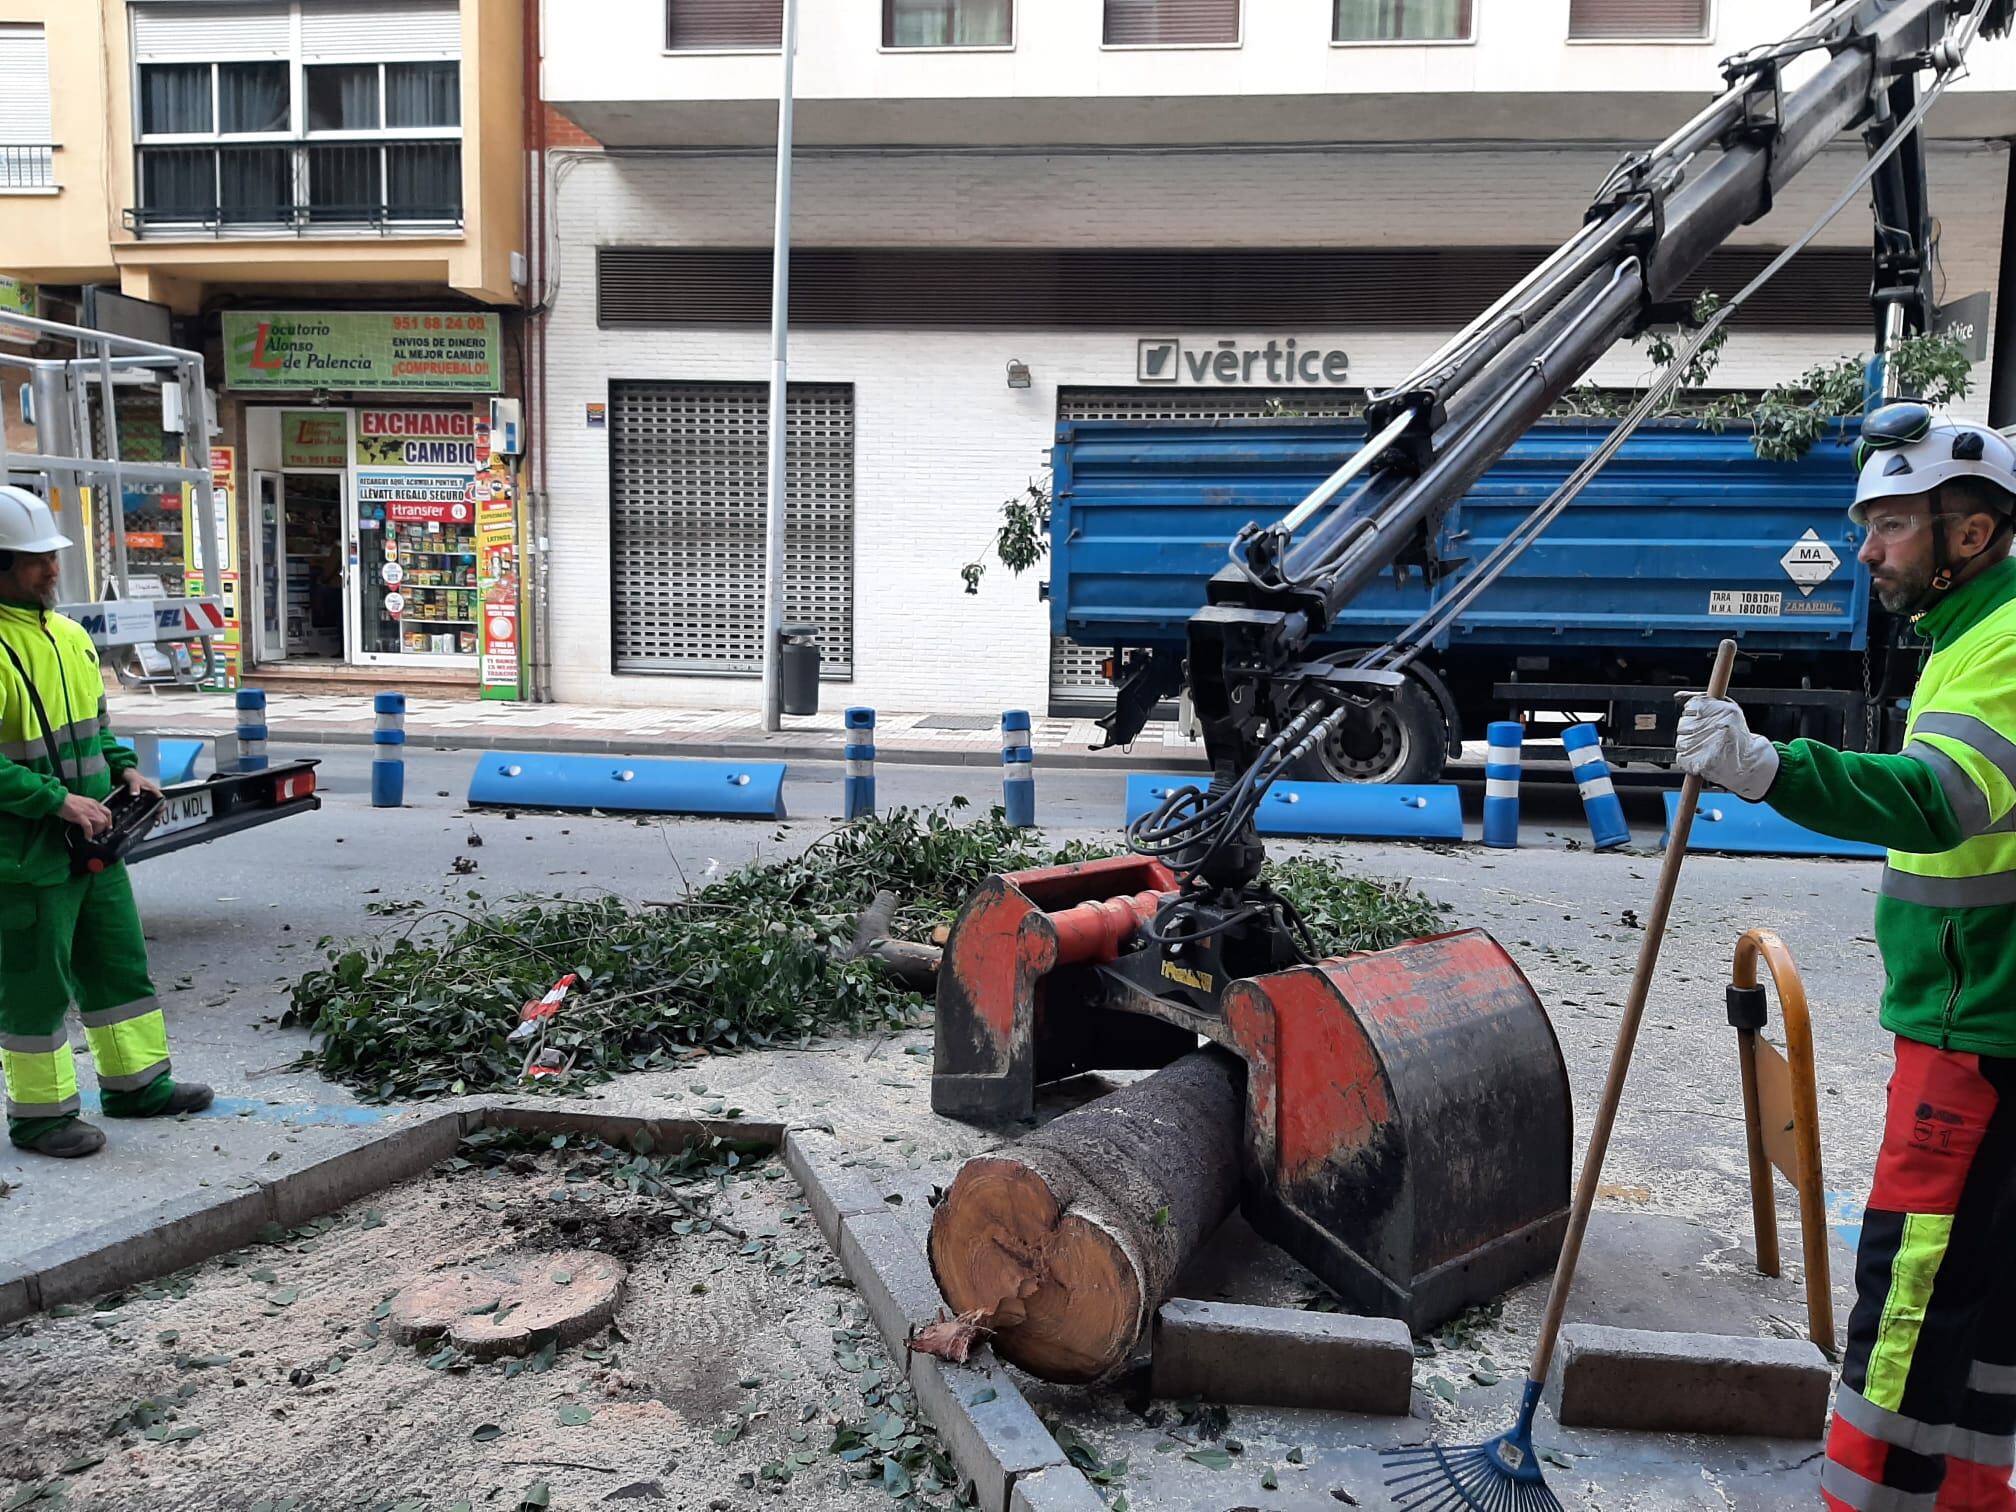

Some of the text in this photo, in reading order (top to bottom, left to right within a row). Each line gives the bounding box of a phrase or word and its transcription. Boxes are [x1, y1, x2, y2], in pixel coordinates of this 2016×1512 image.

[264, 338, 314, 351] Alonso
[392, 338, 486, 347] ENVIOS DE DINERO
[283, 352, 372, 368] de Palencia
[394, 350, 485, 359] AL MEJOR CAMBIO
[405, 441, 474, 463] CAMBIO
[395, 489, 427, 500] REGALO
[429, 490, 464, 501] SEGURO
[1800, 549, 1821, 560] MA
[1713, 592, 1731, 602] TARA
[182, 797, 208, 818] MDL
